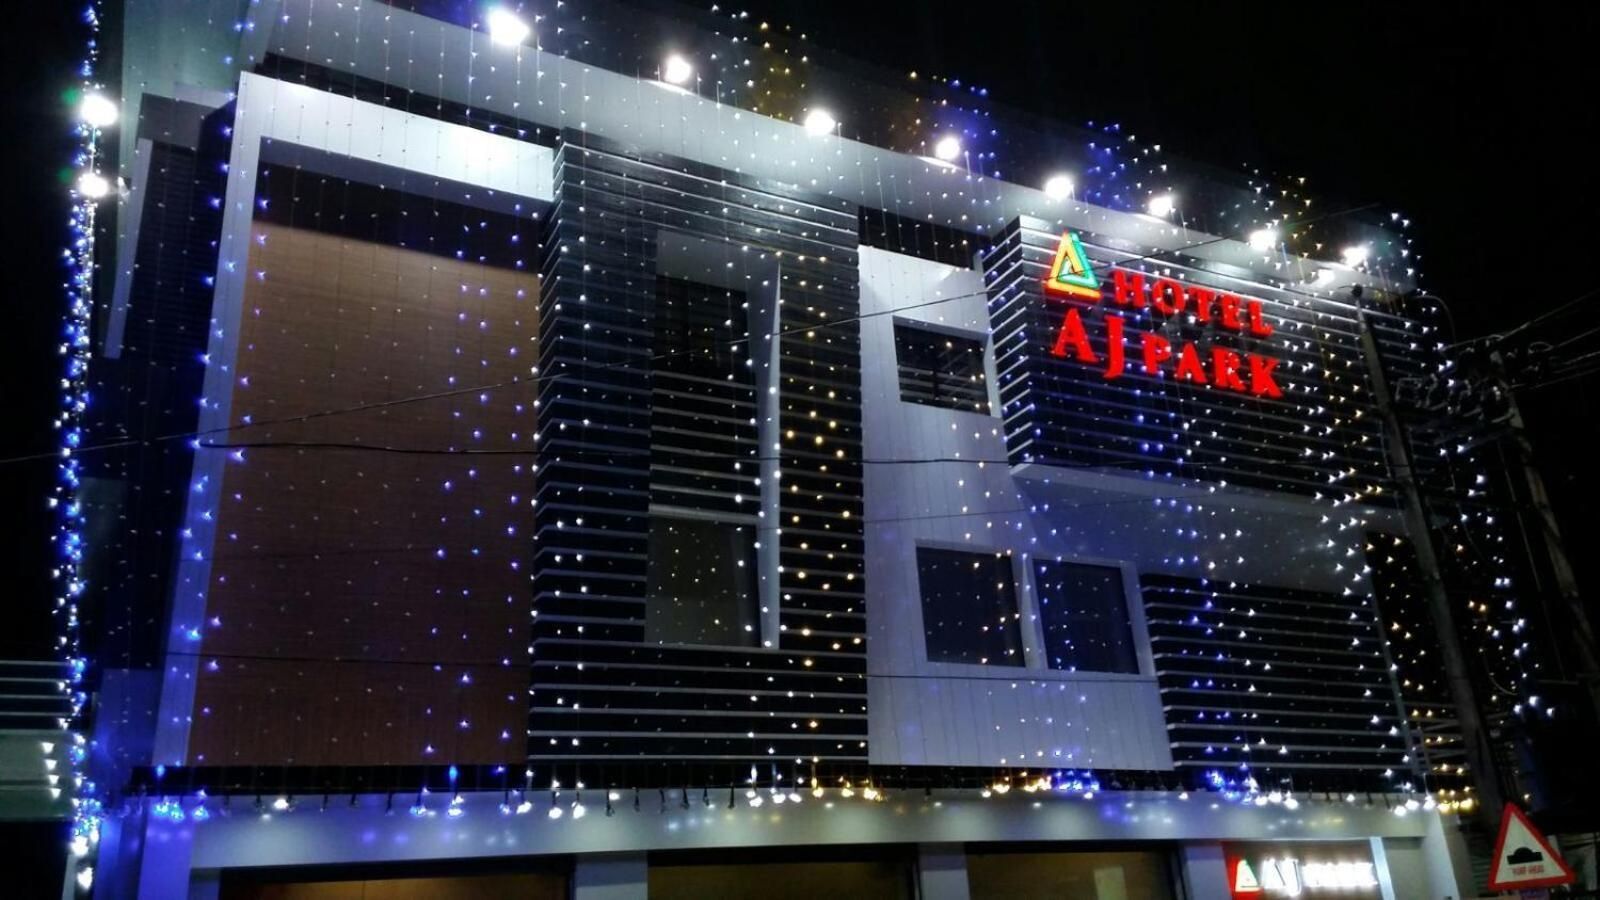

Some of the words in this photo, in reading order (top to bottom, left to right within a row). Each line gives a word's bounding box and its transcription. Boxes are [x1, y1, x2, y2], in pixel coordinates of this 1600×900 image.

[1112, 268, 1274, 337] HOTEL
[1050, 308, 1125, 379] AJ
[1140, 332, 1284, 399] PARK
